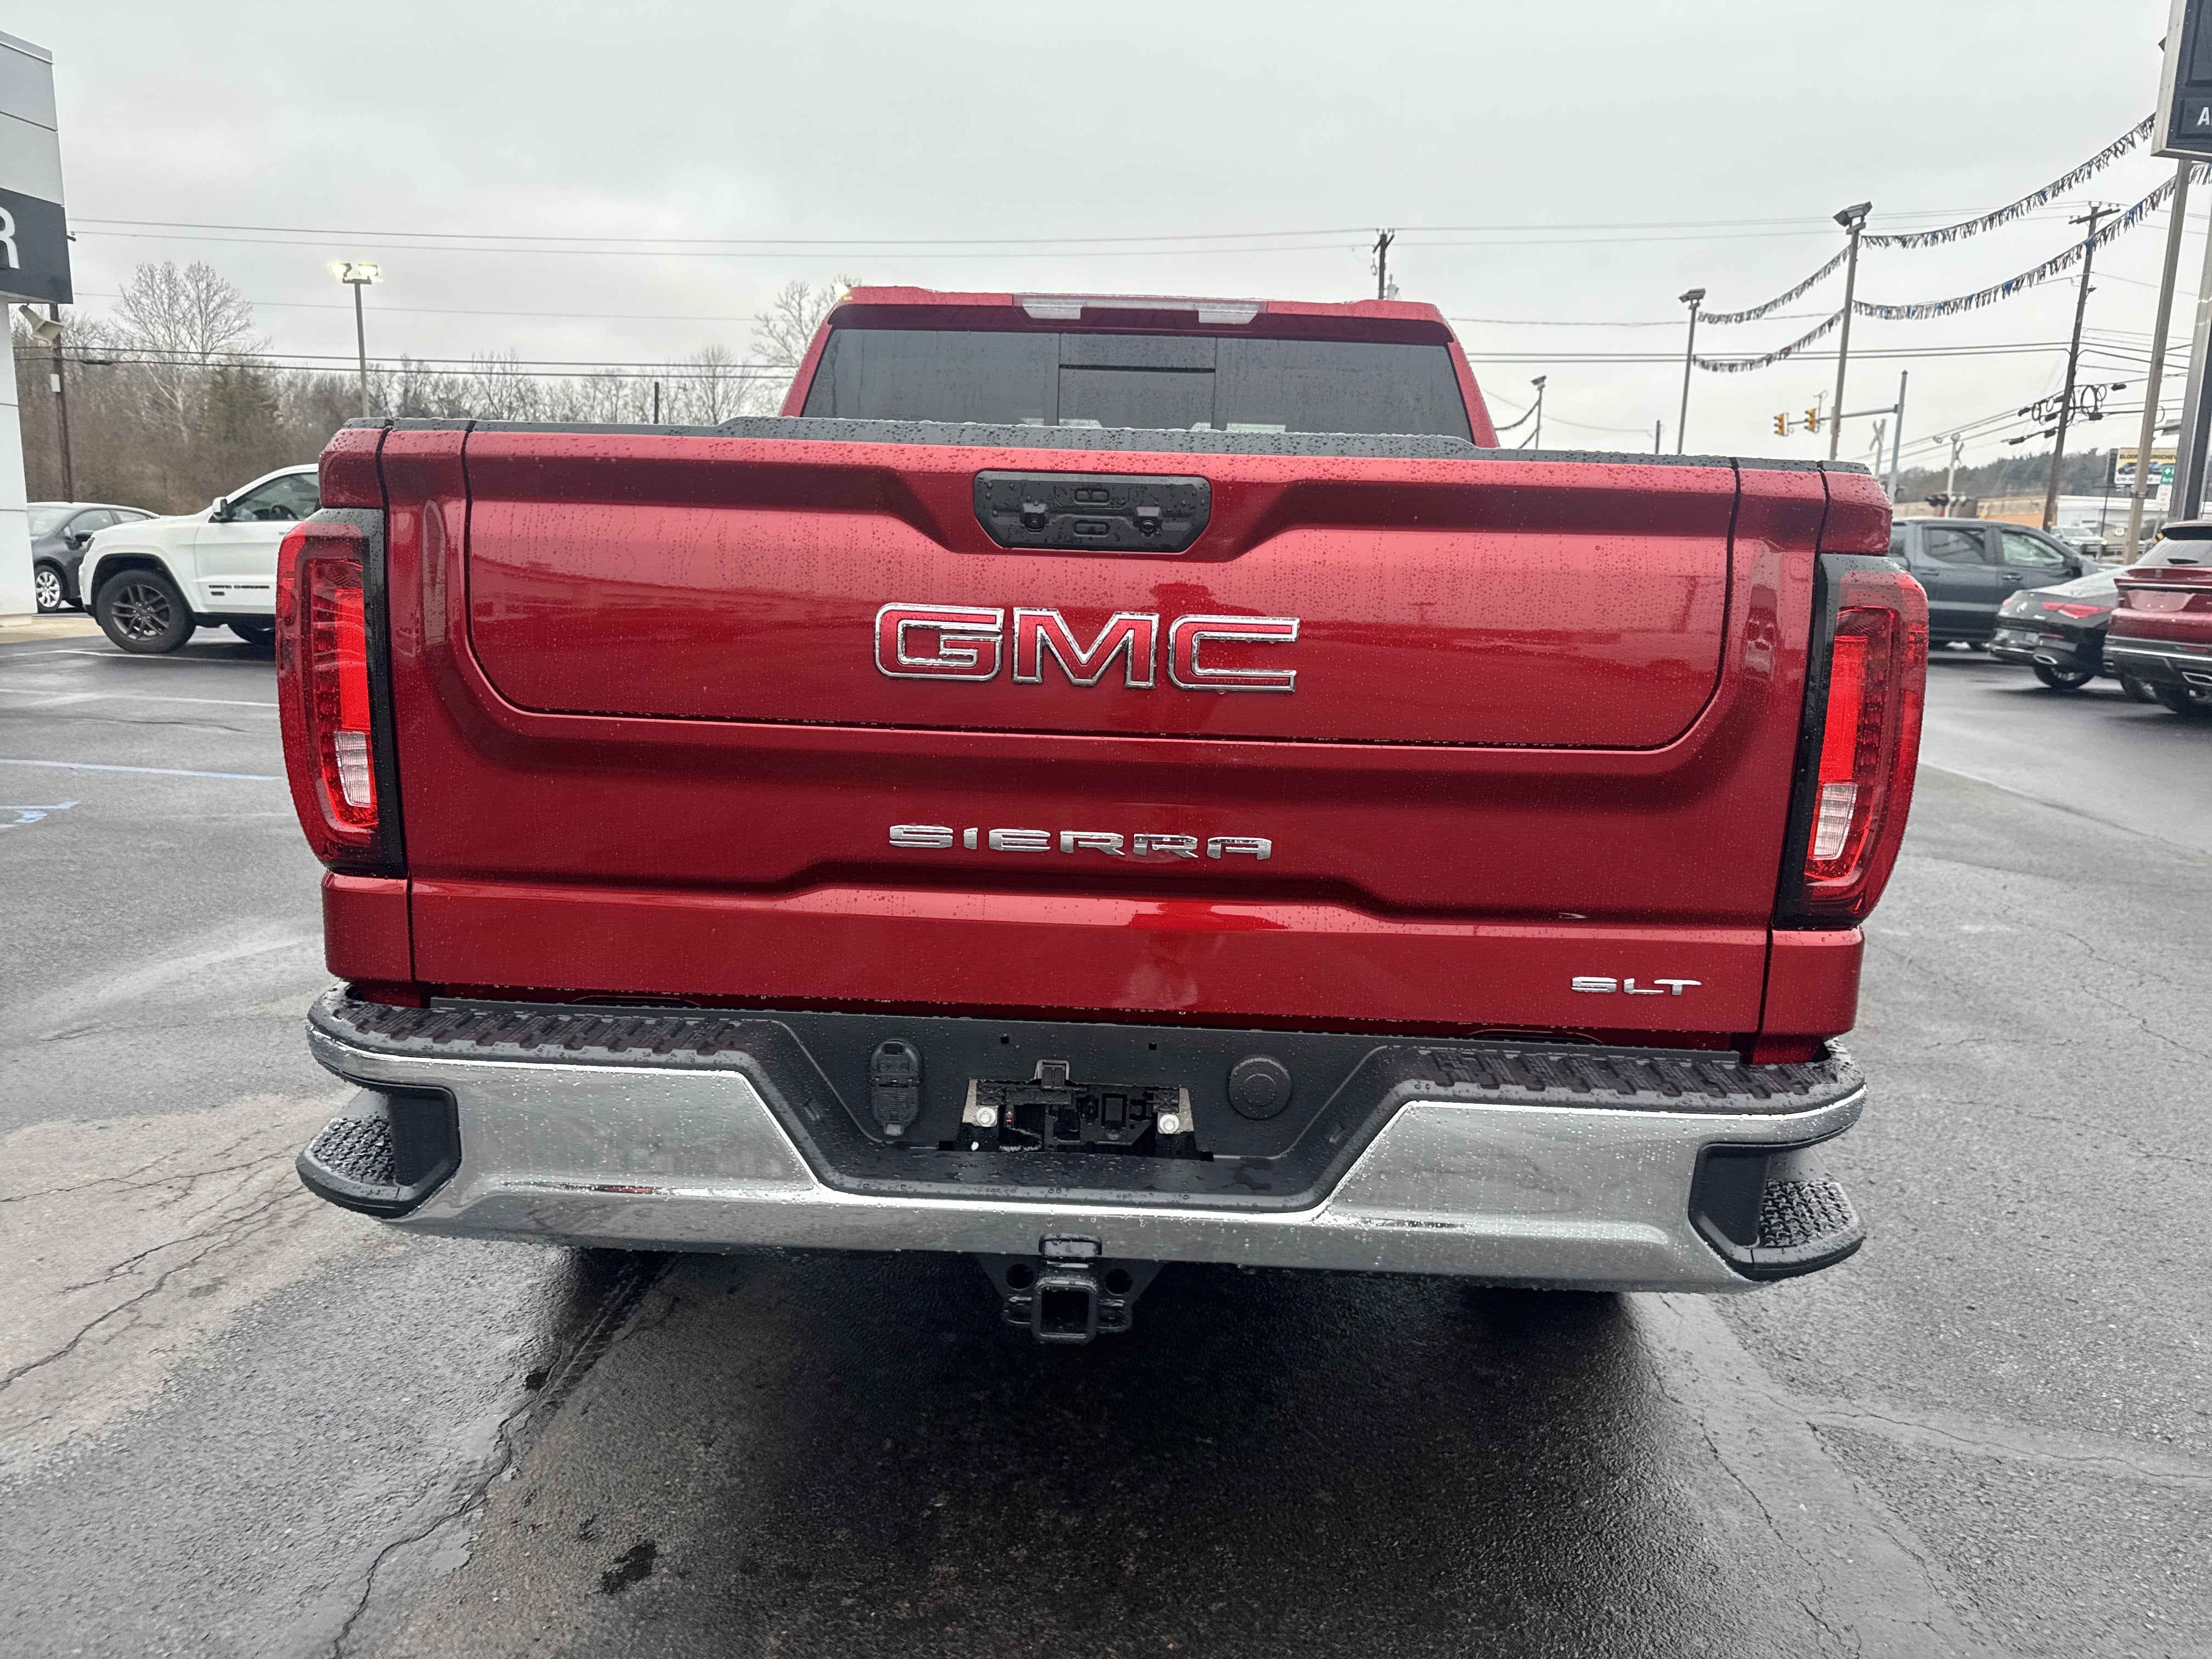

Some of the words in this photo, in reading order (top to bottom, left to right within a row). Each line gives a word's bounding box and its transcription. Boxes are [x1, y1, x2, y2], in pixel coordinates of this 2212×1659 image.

[2197, 107, 2212, 126] A
[873, 602, 1301, 693] GMC
[889, 825, 1272, 860] SIERRA
[1571, 977, 1702, 996] SLT
